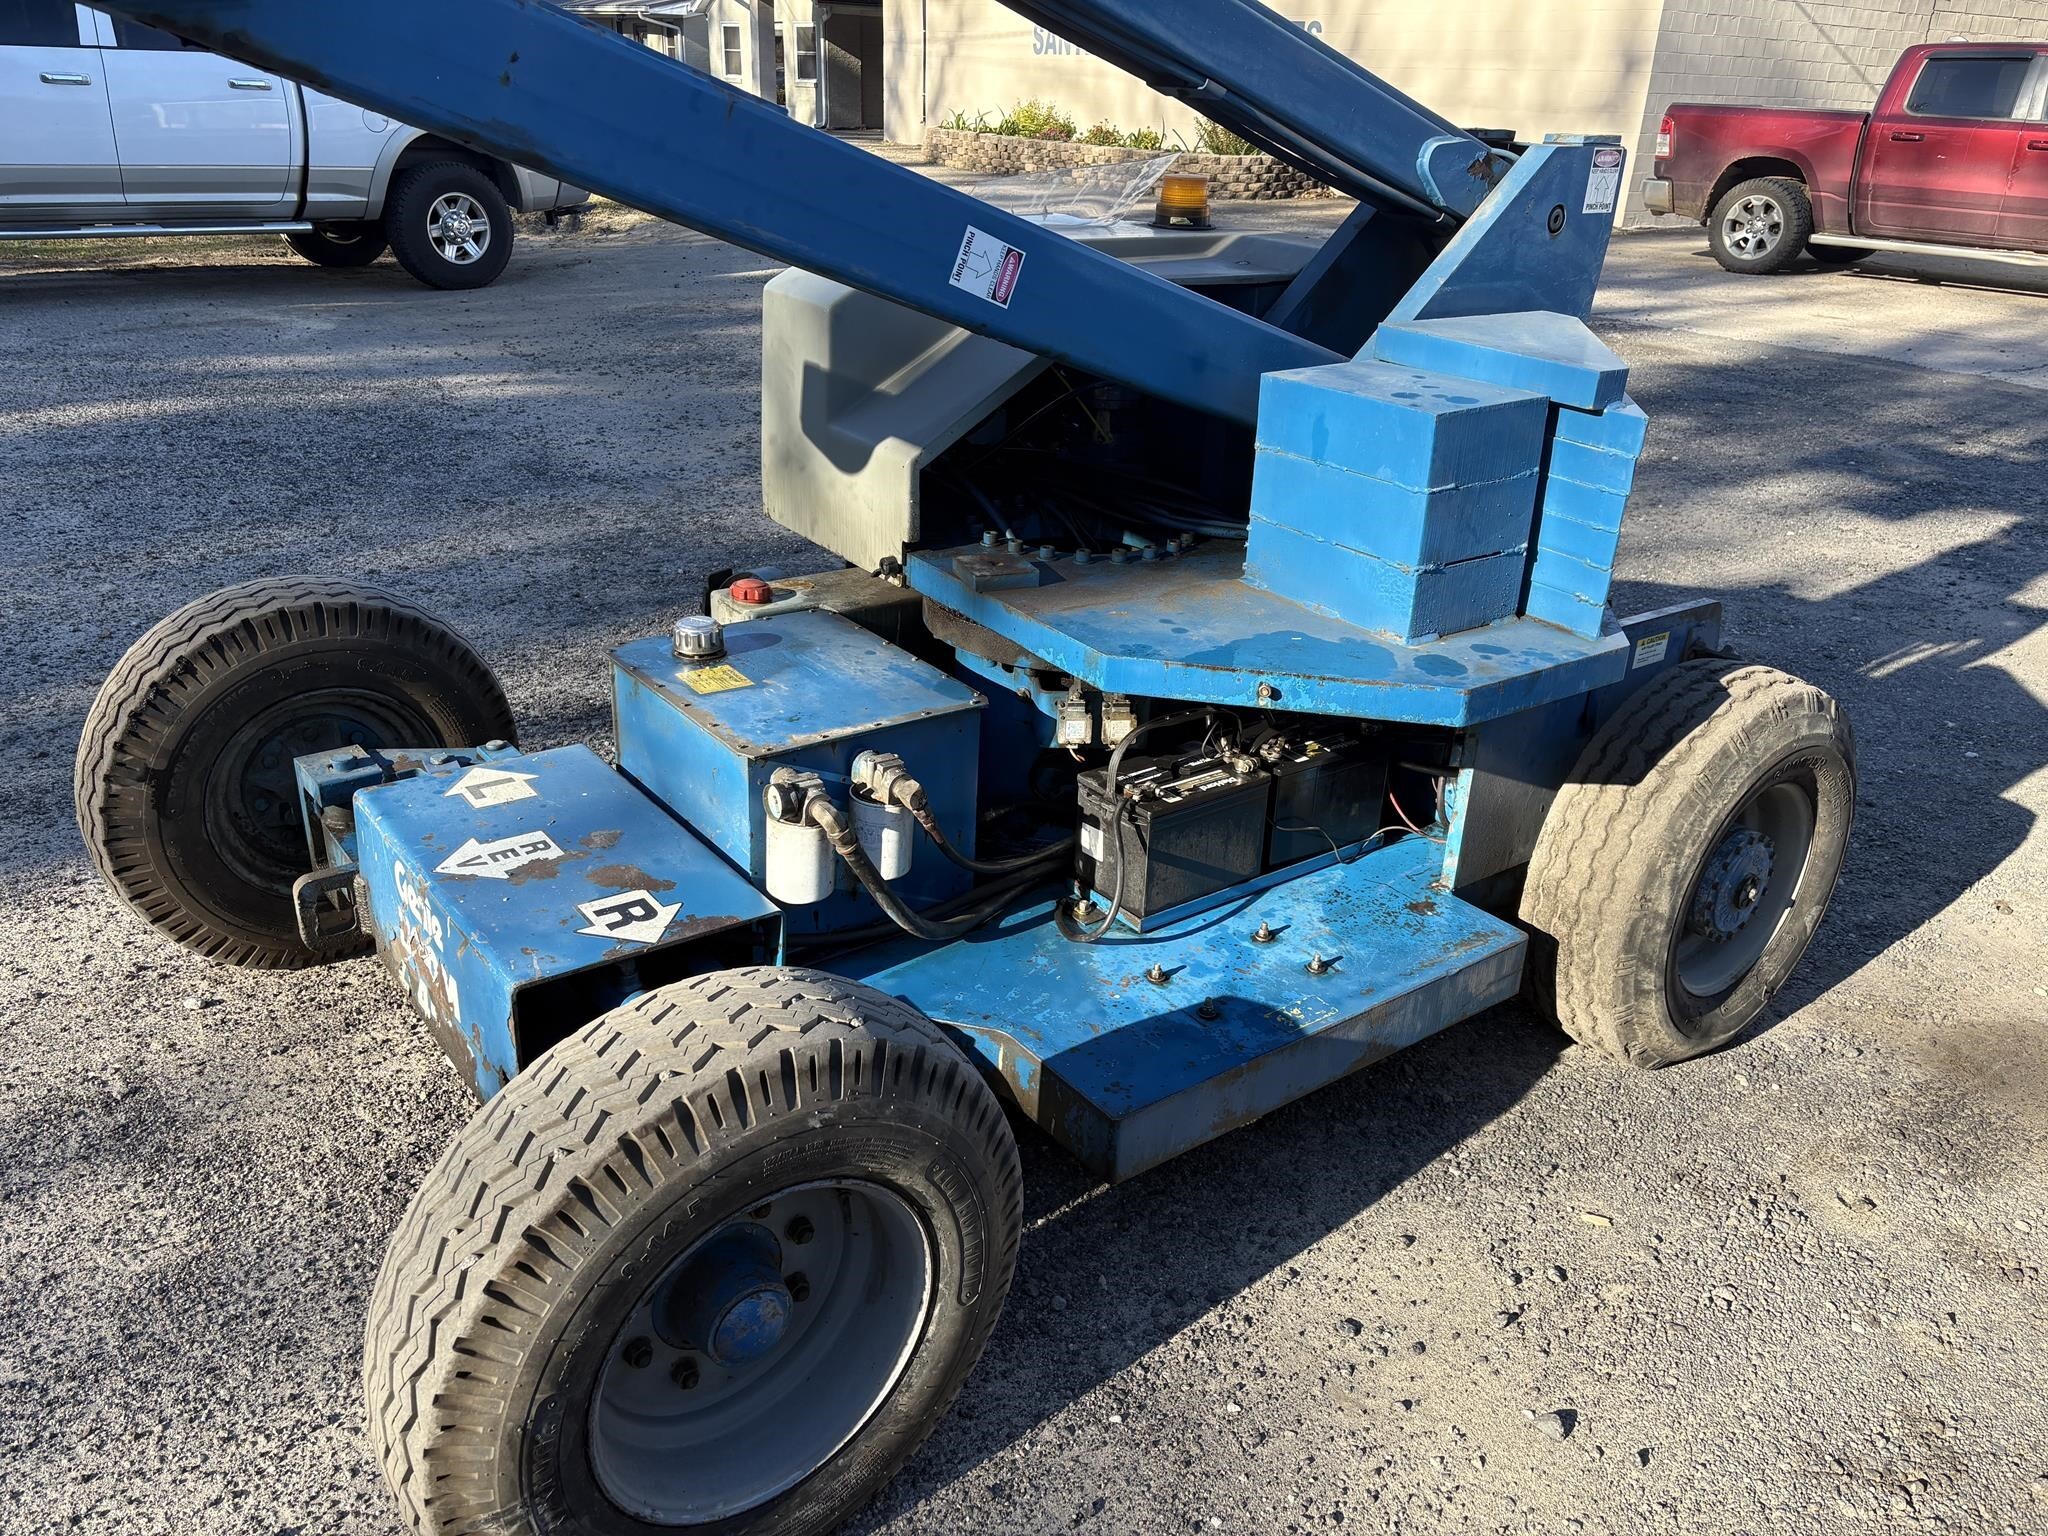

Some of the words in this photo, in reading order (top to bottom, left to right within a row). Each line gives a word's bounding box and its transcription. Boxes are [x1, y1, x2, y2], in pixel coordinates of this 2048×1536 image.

[1033, 25, 1090, 55] SAN
[962, 231, 975, 257] PINCH
[952, 257, 966, 283] POINT
[998, 263, 1014, 297] WARNING
[465, 777, 515, 799] L
[455, 839, 552, 868] REV
[593, 897, 658, 931] R
